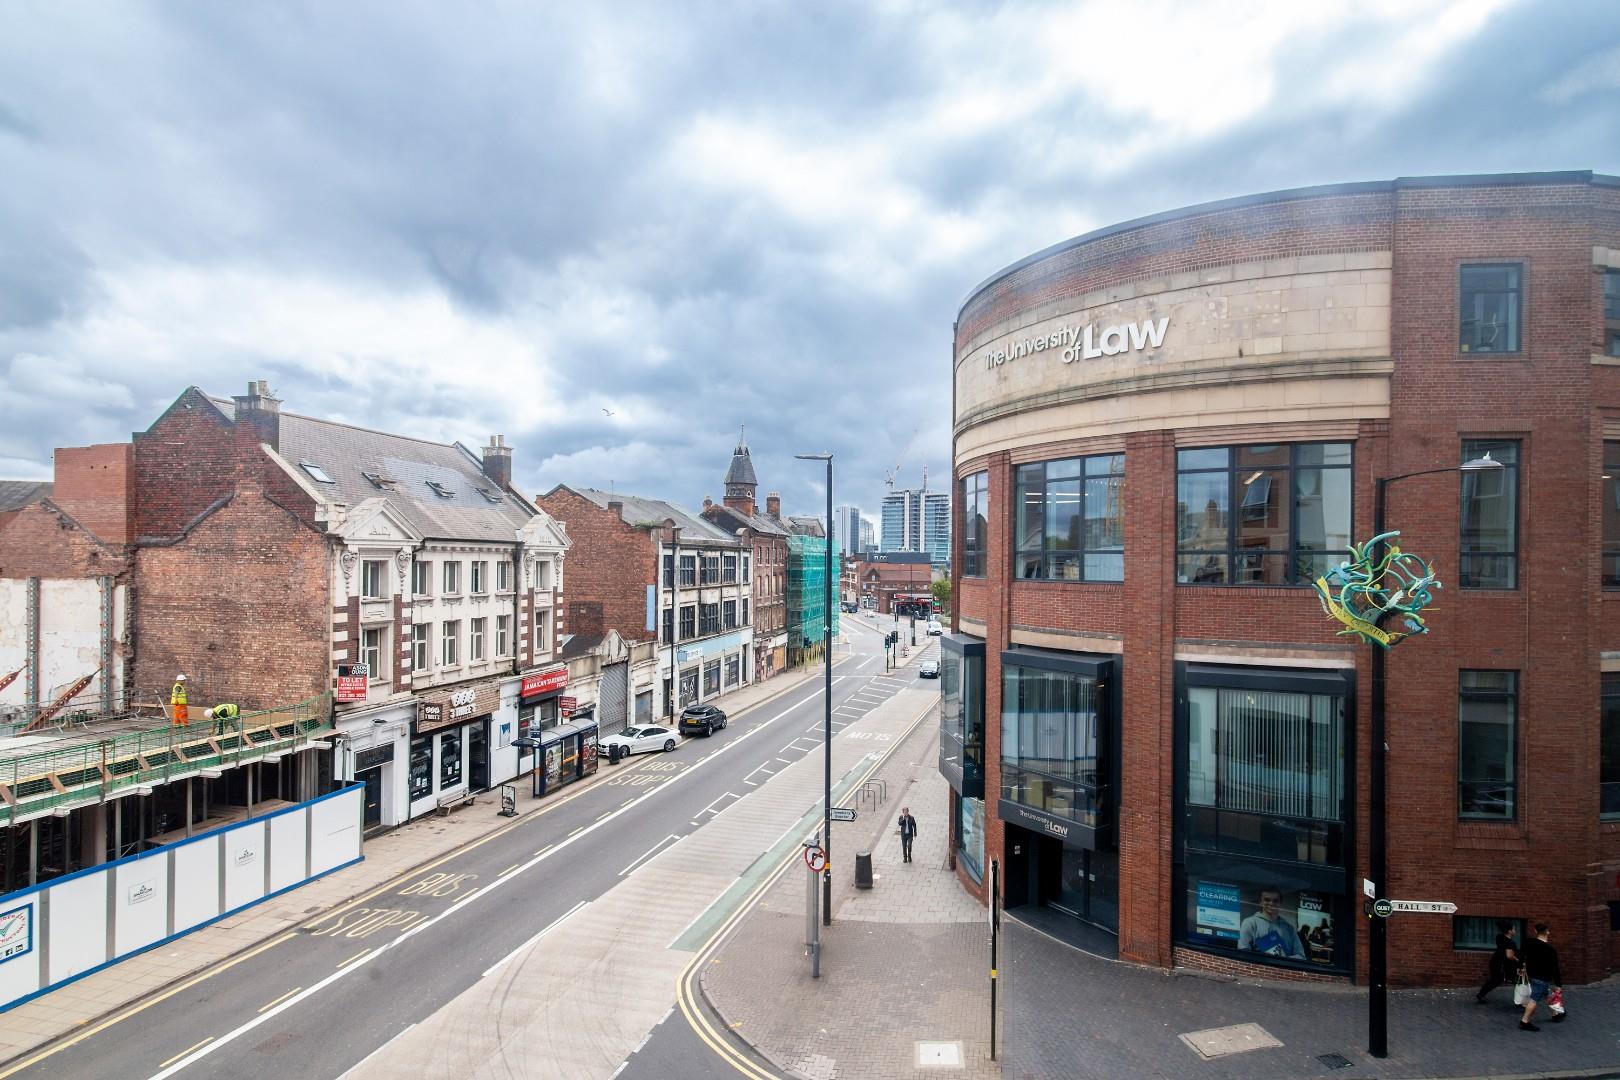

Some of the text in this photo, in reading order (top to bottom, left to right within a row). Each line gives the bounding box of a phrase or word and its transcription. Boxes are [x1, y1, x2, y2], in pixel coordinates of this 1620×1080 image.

[985, 324, 1082, 370] The University
[1061, 316, 1170, 364] of Law
[640, 761, 684, 772] BUS
[1050, 821, 1068, 835] Law
[397, 873, 479, 897] BUS
[1199, 891, 1238, 902] CLEARING
[1300, 899, 1323, 911] Law
[311, 908, 420, 939] STOP
